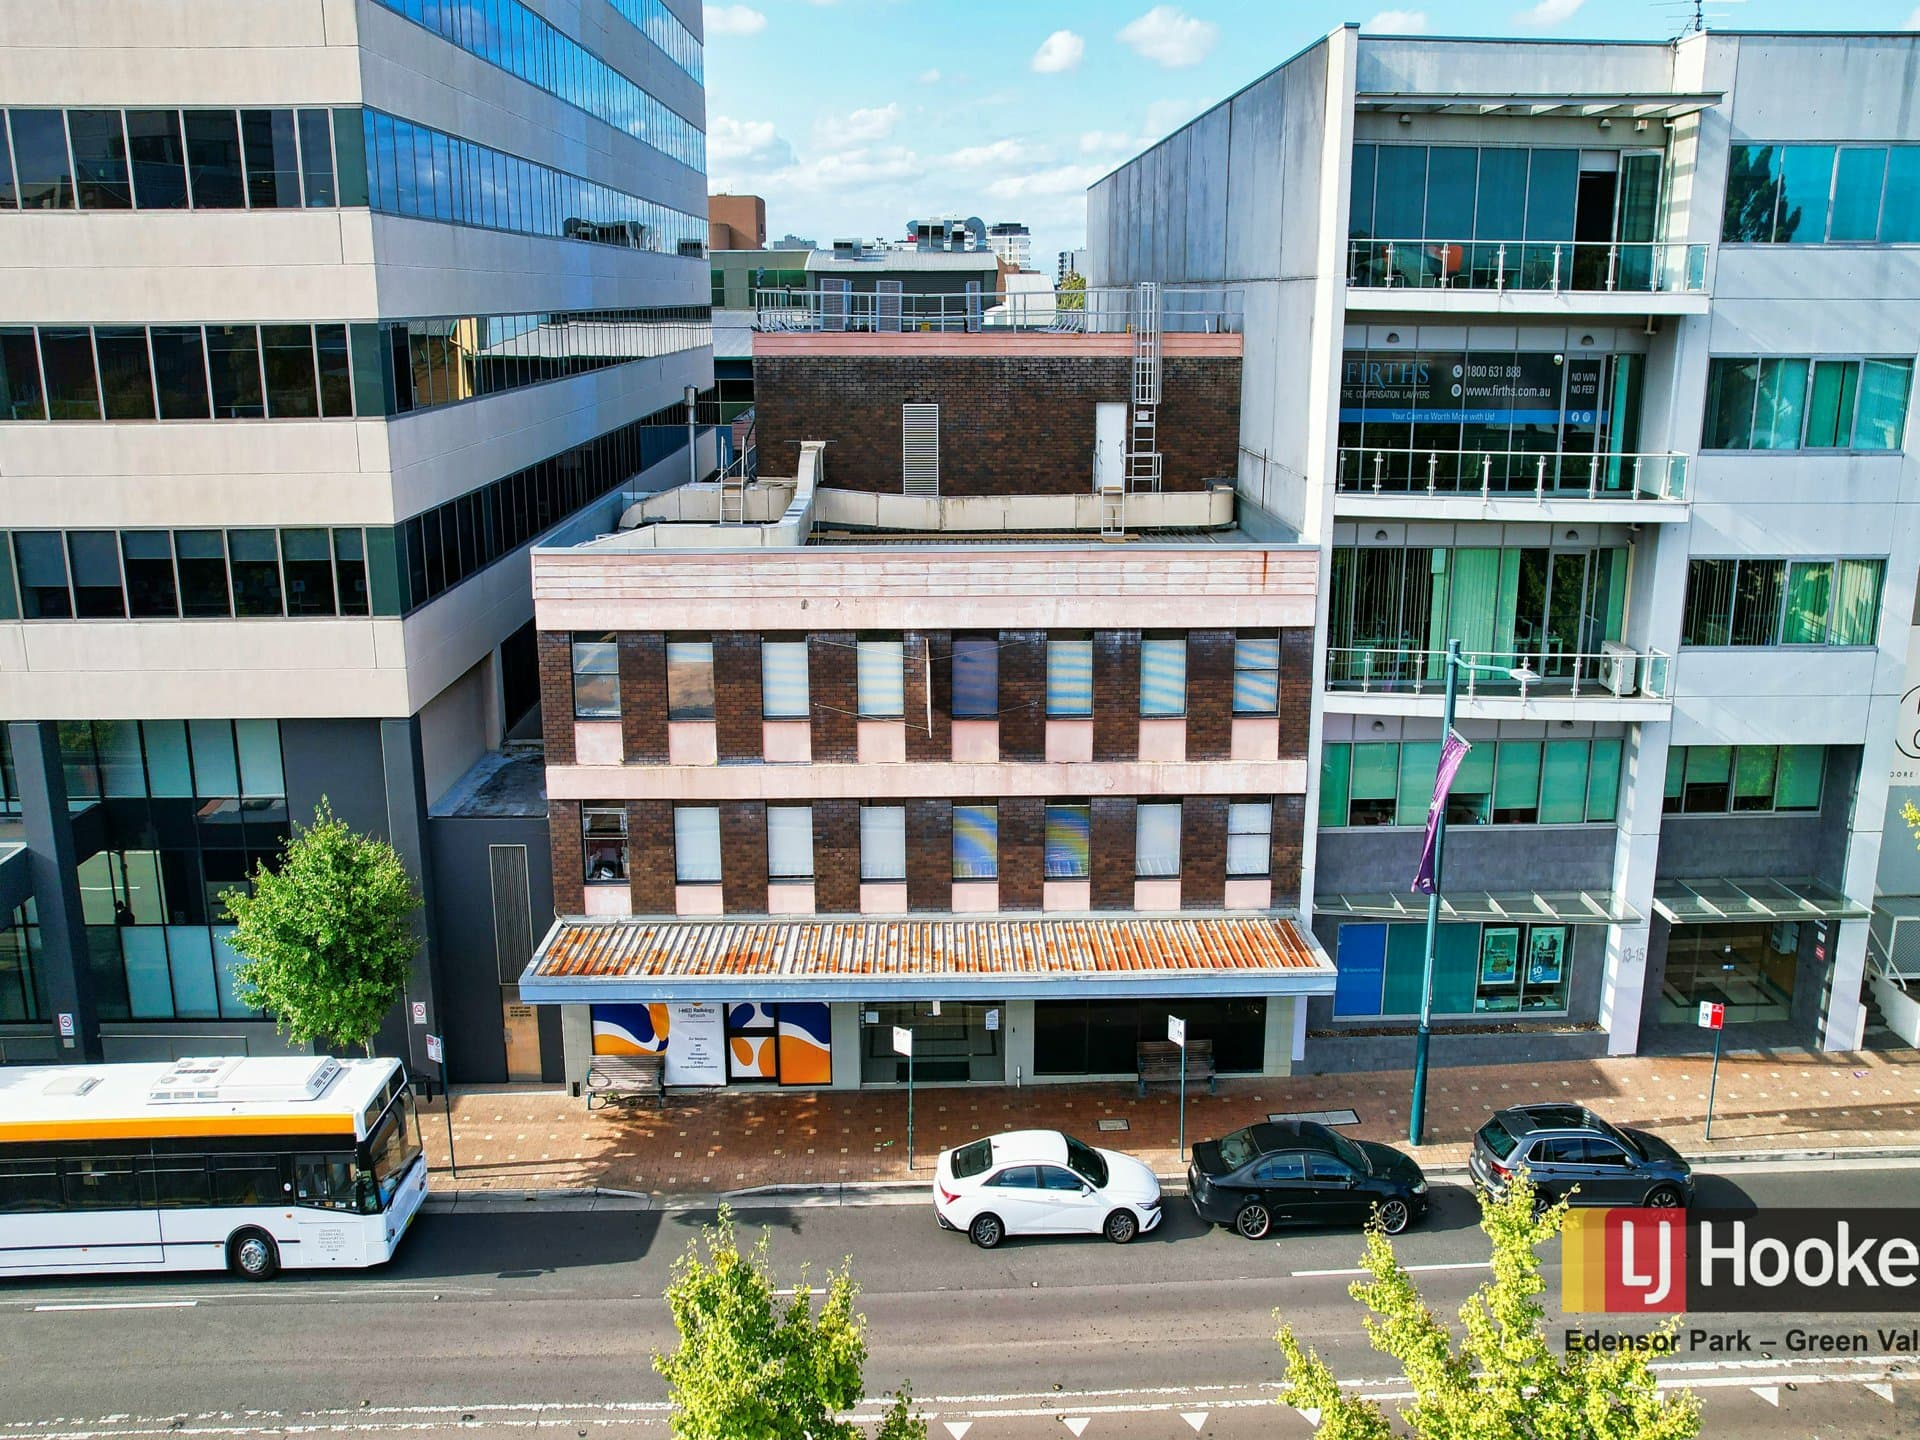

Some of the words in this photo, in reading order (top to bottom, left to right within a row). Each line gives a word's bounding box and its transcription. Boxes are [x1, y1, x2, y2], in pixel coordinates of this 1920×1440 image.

[1346, 362, 1430, 388] FIRTHS
[1467, 365, 1487, 377] 1800
[1488, 366, 1503, 378] 631
[1505, 366, 1522, 378] 888
[1571, 373, 1582, 382] NO
[1582, 373, 1597, 382] WIN
[1466, 385, 1551, 397] www.firths.com.au
[1570, 384, 1581, 394] NO
[1343, 390, 1353, 399] THE
[1402, 390, 1431, 400] LAWYERS
[1391, 411, 1406, 421] Your
[1430, 411, 1451, 421] Worth
